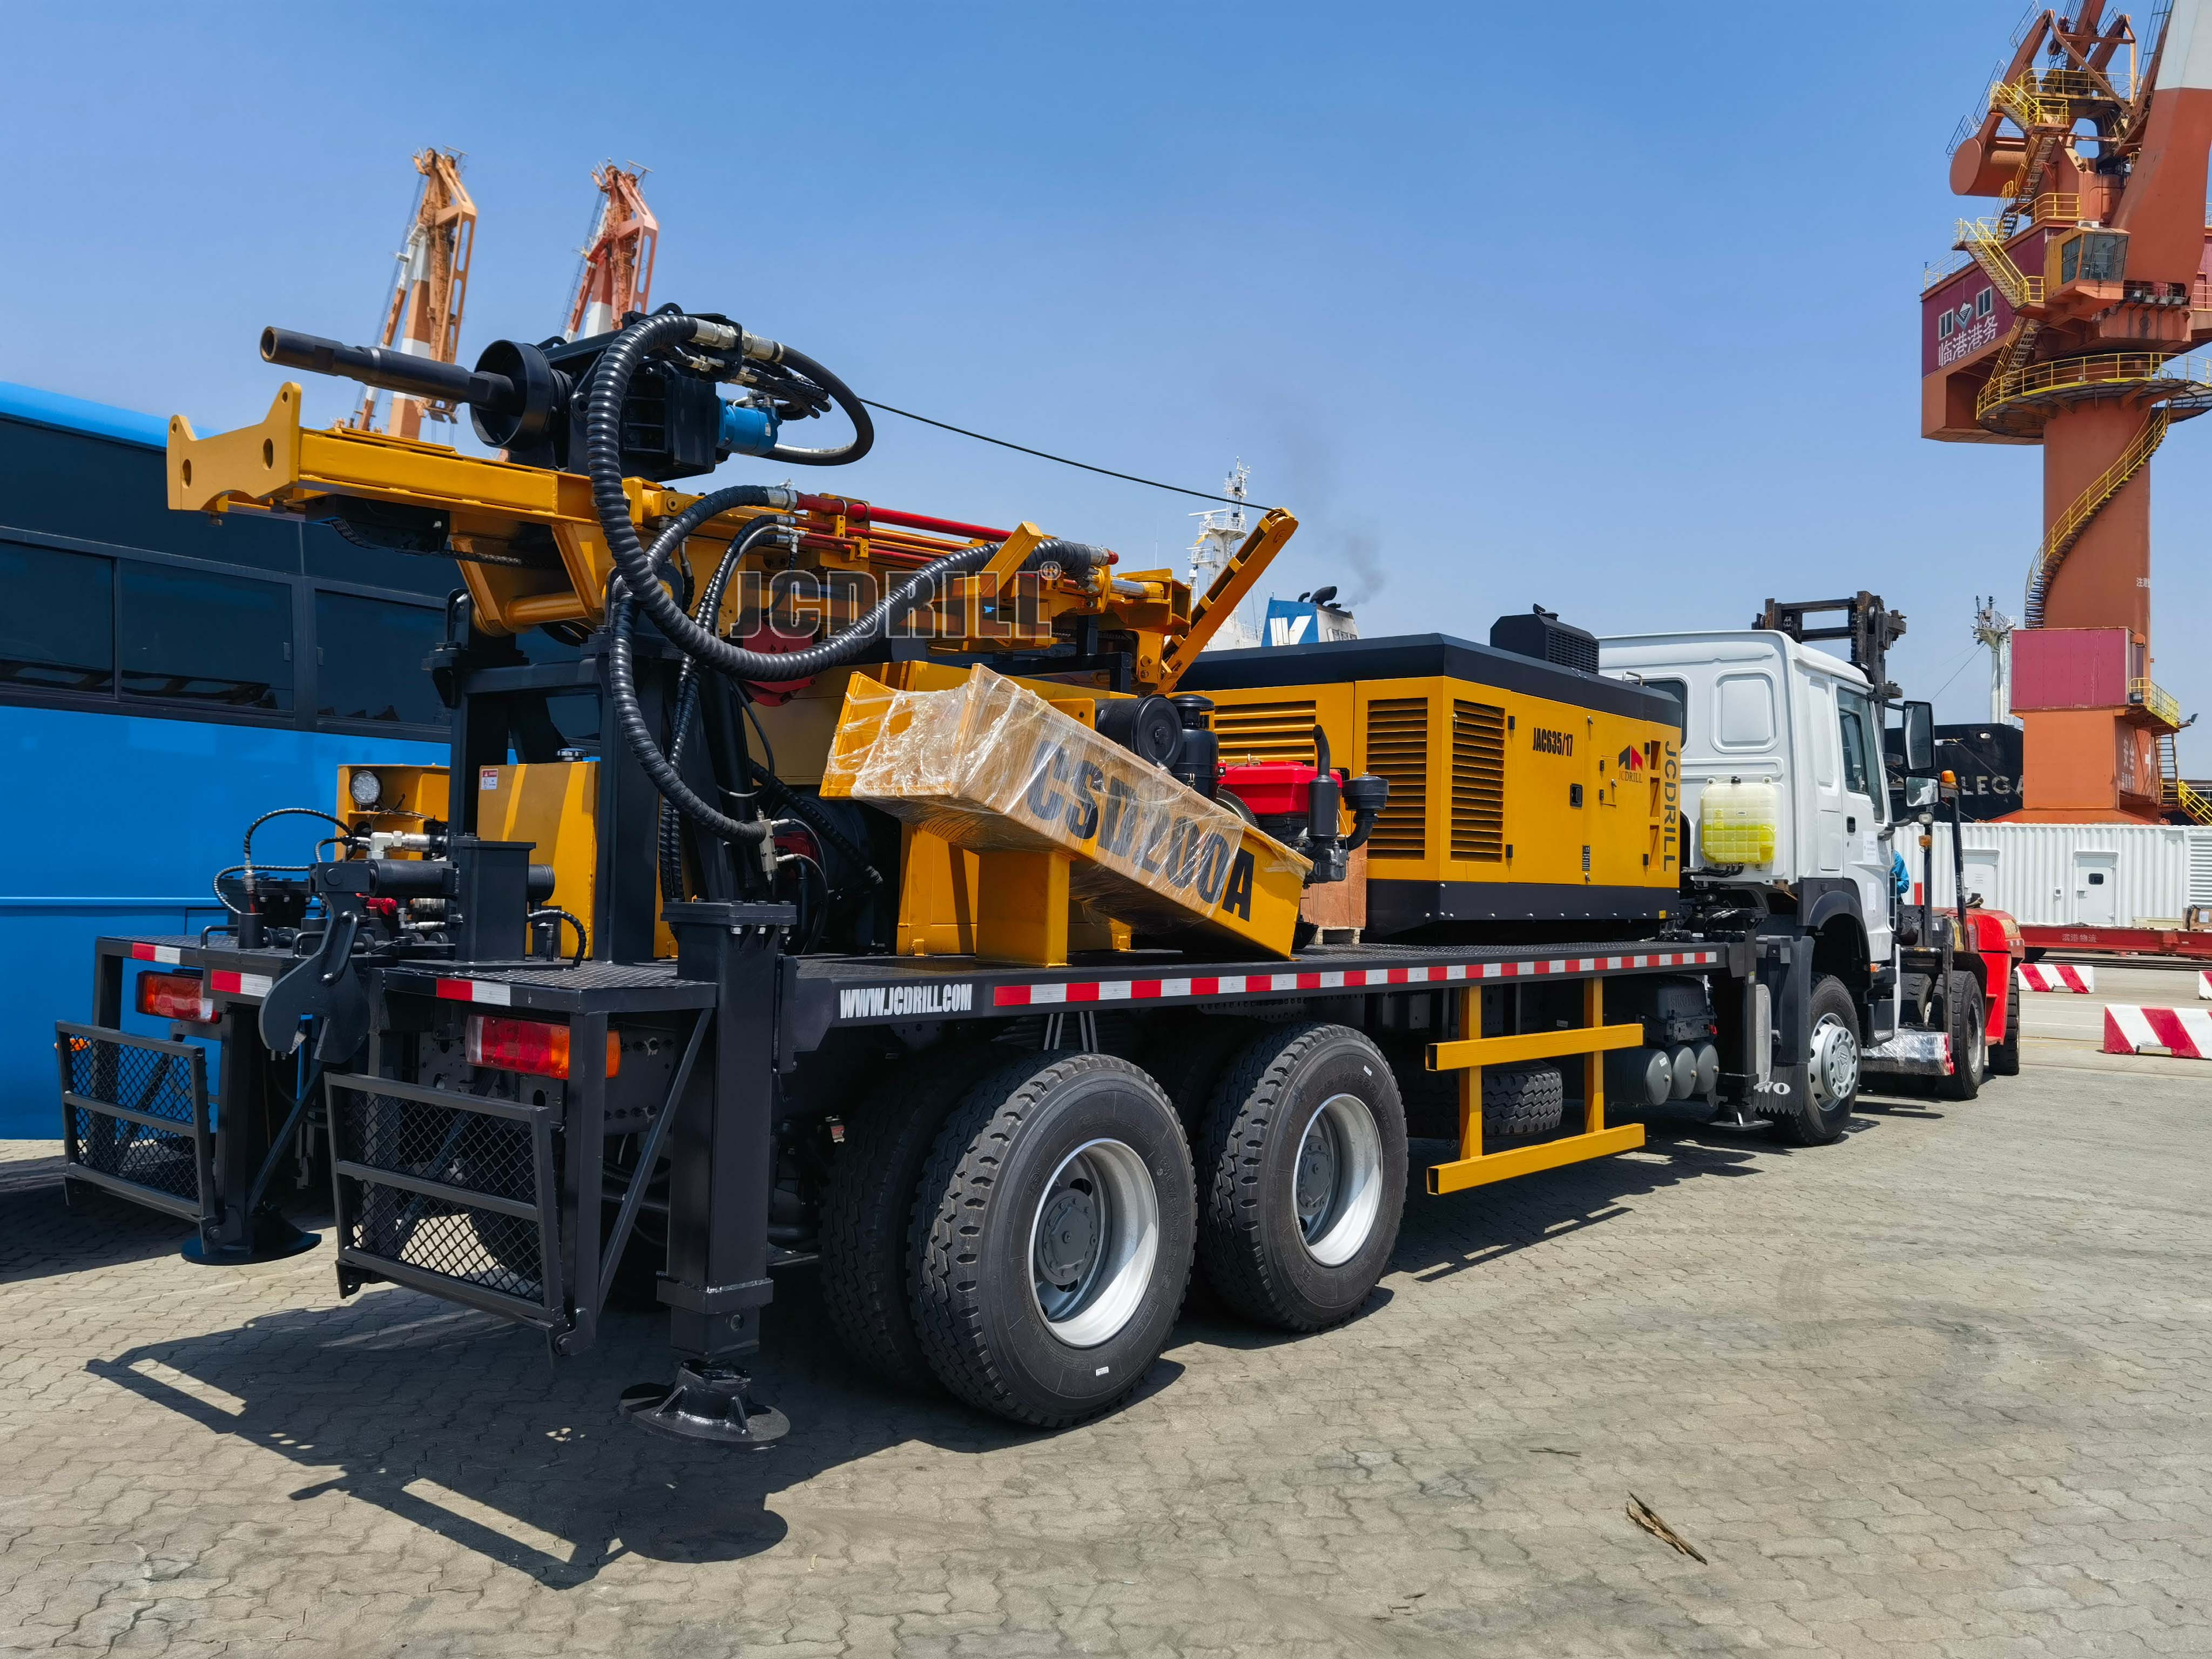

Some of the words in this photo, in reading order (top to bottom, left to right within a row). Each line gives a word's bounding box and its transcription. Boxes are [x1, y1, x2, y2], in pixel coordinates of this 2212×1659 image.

[1938, 315, 1998, 367] 临港港务
[1533, 727, 1573, 757] JAC635/17
[1618, 769, 1643, 783] JCDRILL
[1664, 740, 1677, 872] JCDRILL
[840, 983, 973, 1019] WWW.JCDRILL.COM
